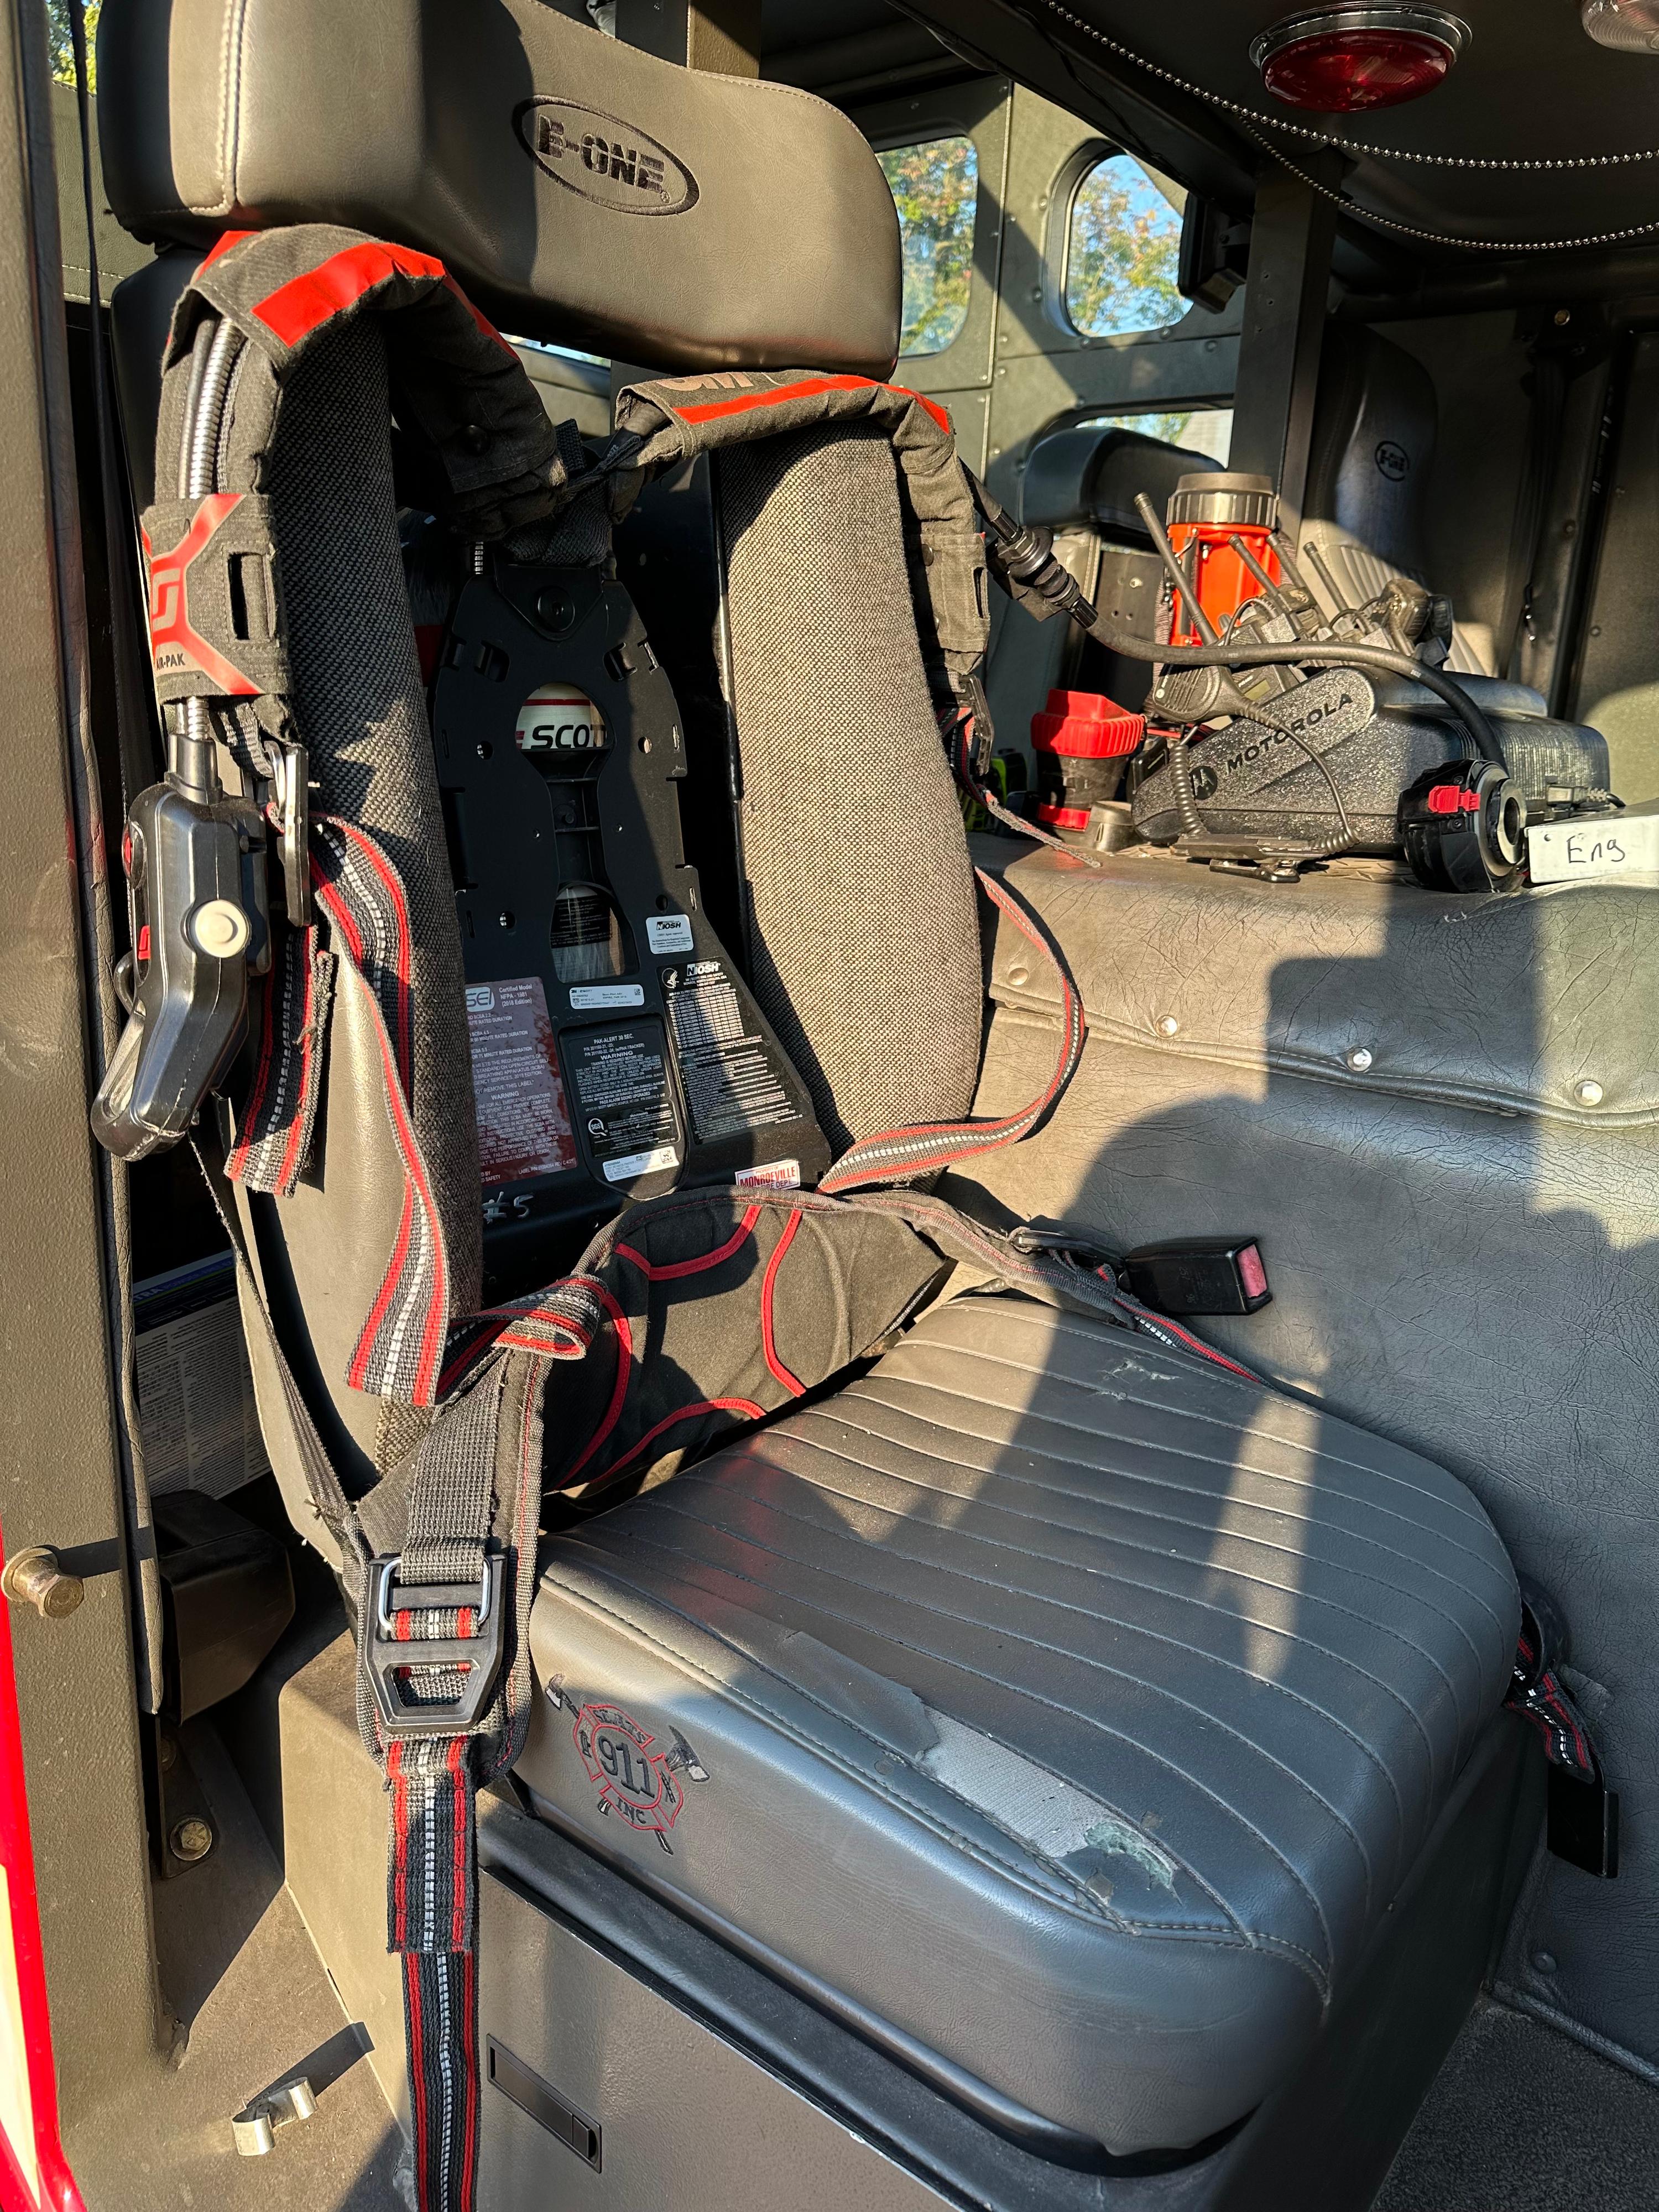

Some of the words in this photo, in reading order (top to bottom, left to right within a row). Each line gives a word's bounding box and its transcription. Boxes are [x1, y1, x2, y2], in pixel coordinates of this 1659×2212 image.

[1226, 693, 1353, 774] MOTOROLA
[1566, 833, 1625, 863] Eng
[656, 921, 681, 931] NIOSH
[687, 963, 719, 977] NIOSH
[593, 1036, 618, 1044] PAK-ALERT
[600, 1050, 633, 1060] WARNING
[483, 1084, 505, 1093] REMOVE
[491, 1091, 519, 1100] WARNING
[740, 1166, 796, 1188] MONROEVILLE
[598, 1735, 655, 1799] 911
[616, 1796, 646, 1824] INC
